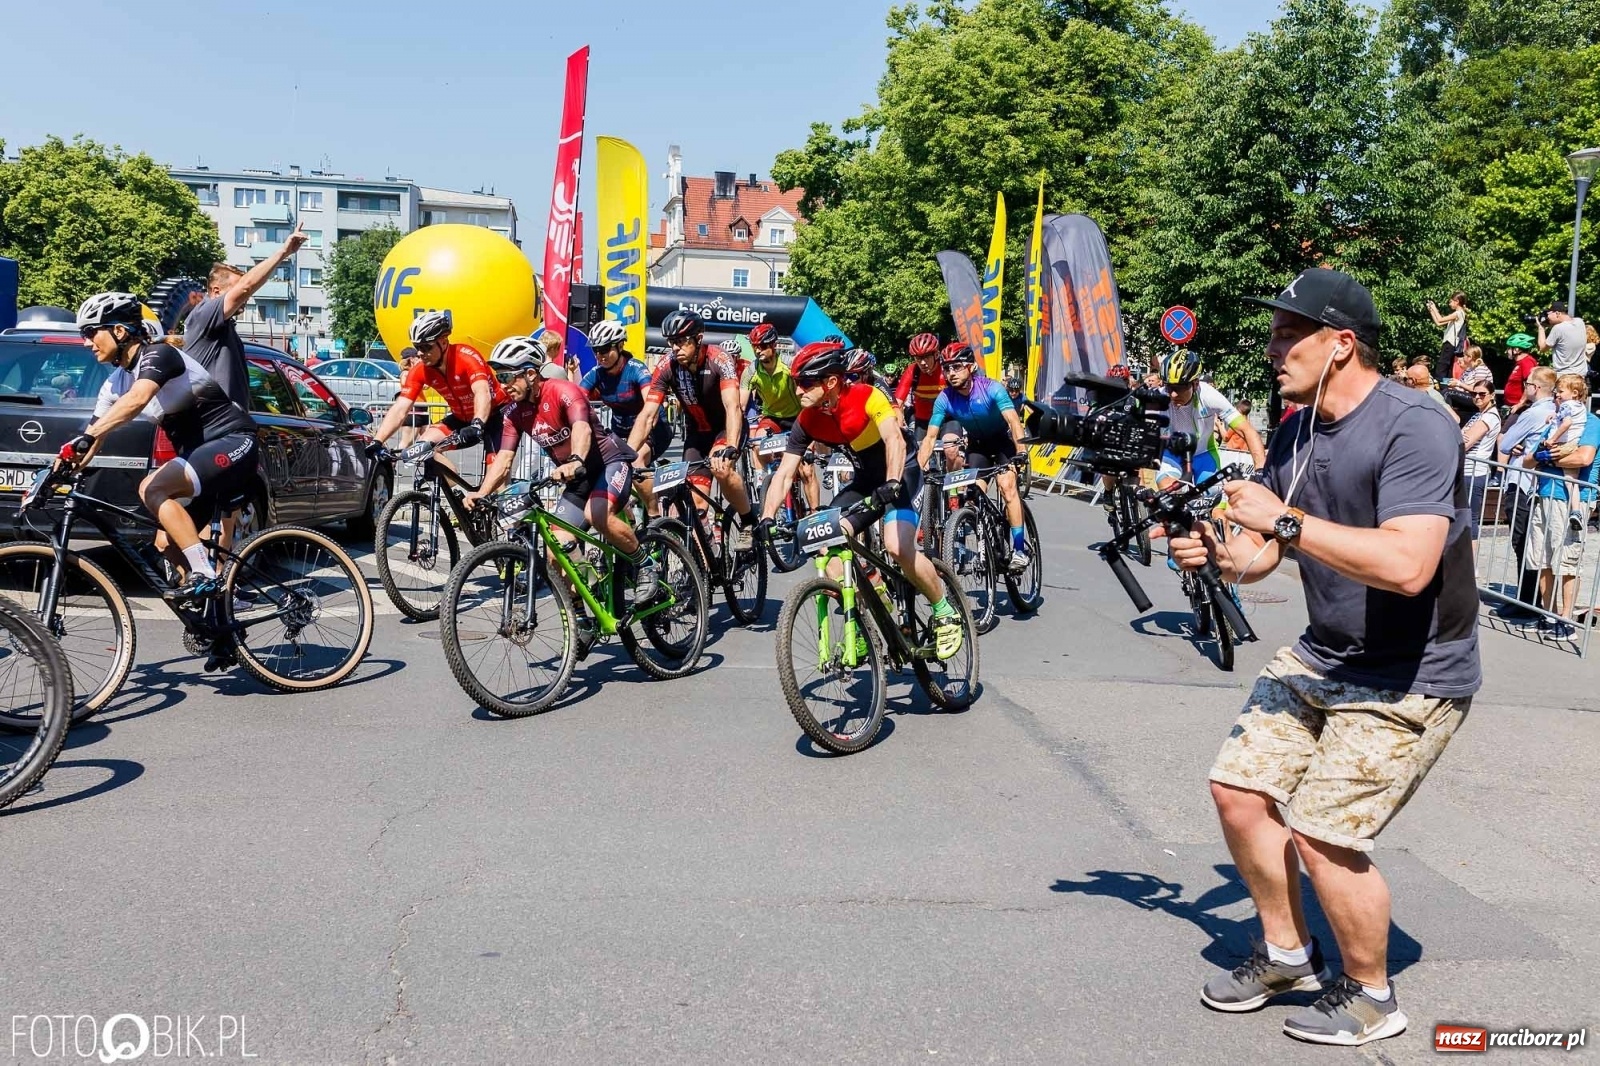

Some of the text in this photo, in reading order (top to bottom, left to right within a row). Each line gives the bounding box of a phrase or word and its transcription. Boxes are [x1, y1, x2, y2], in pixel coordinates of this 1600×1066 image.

[716, 307, 767, 324] atelier
[659, 469, 681, 483] 1755
[805, 521, 833, 540] 2166
